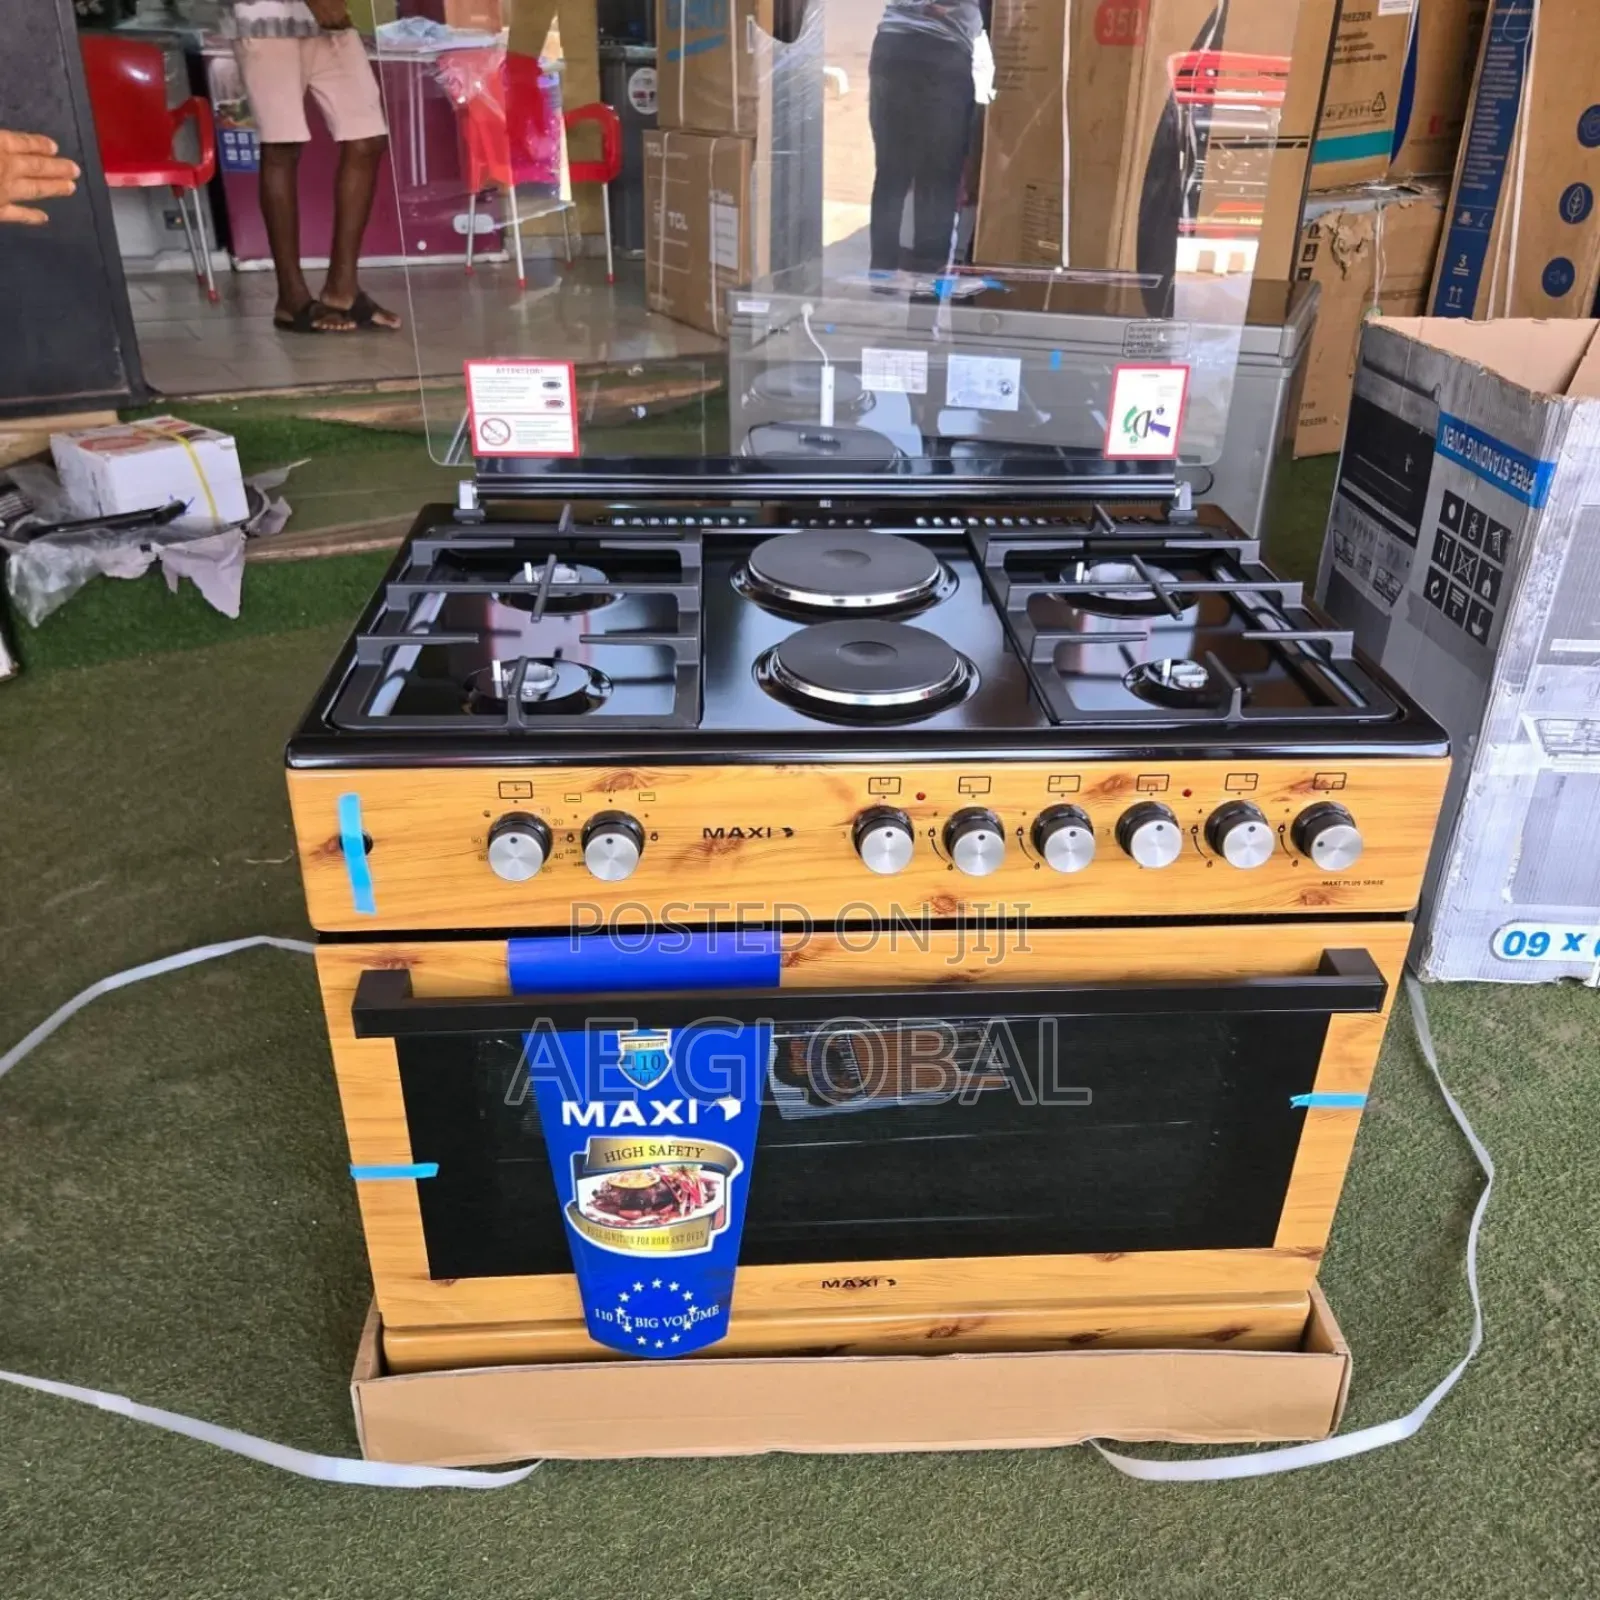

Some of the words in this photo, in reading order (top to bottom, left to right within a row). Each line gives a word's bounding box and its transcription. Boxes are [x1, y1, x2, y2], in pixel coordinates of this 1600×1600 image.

[668, 211, 688, 231] TCL
[1441, 424, 1467, 457] OVEN
[1466, 437, 1511, 480] STANDING
[1510, 462, 1537, 495] FREE
[703, 826, 771, 839] MAXI
[561, 1098, 698, 1128] MAXI
[603, 1145, 644, 1164] HIGH
[648, 1144, 706, 1159] SAFETY
[821, 1278, 879, 1289] MAXI
[594, 1308, 613, 1322] 110
[635, 1317, 659, 1329] BIG
[662, 1304, 720, 1328] VOLUME
